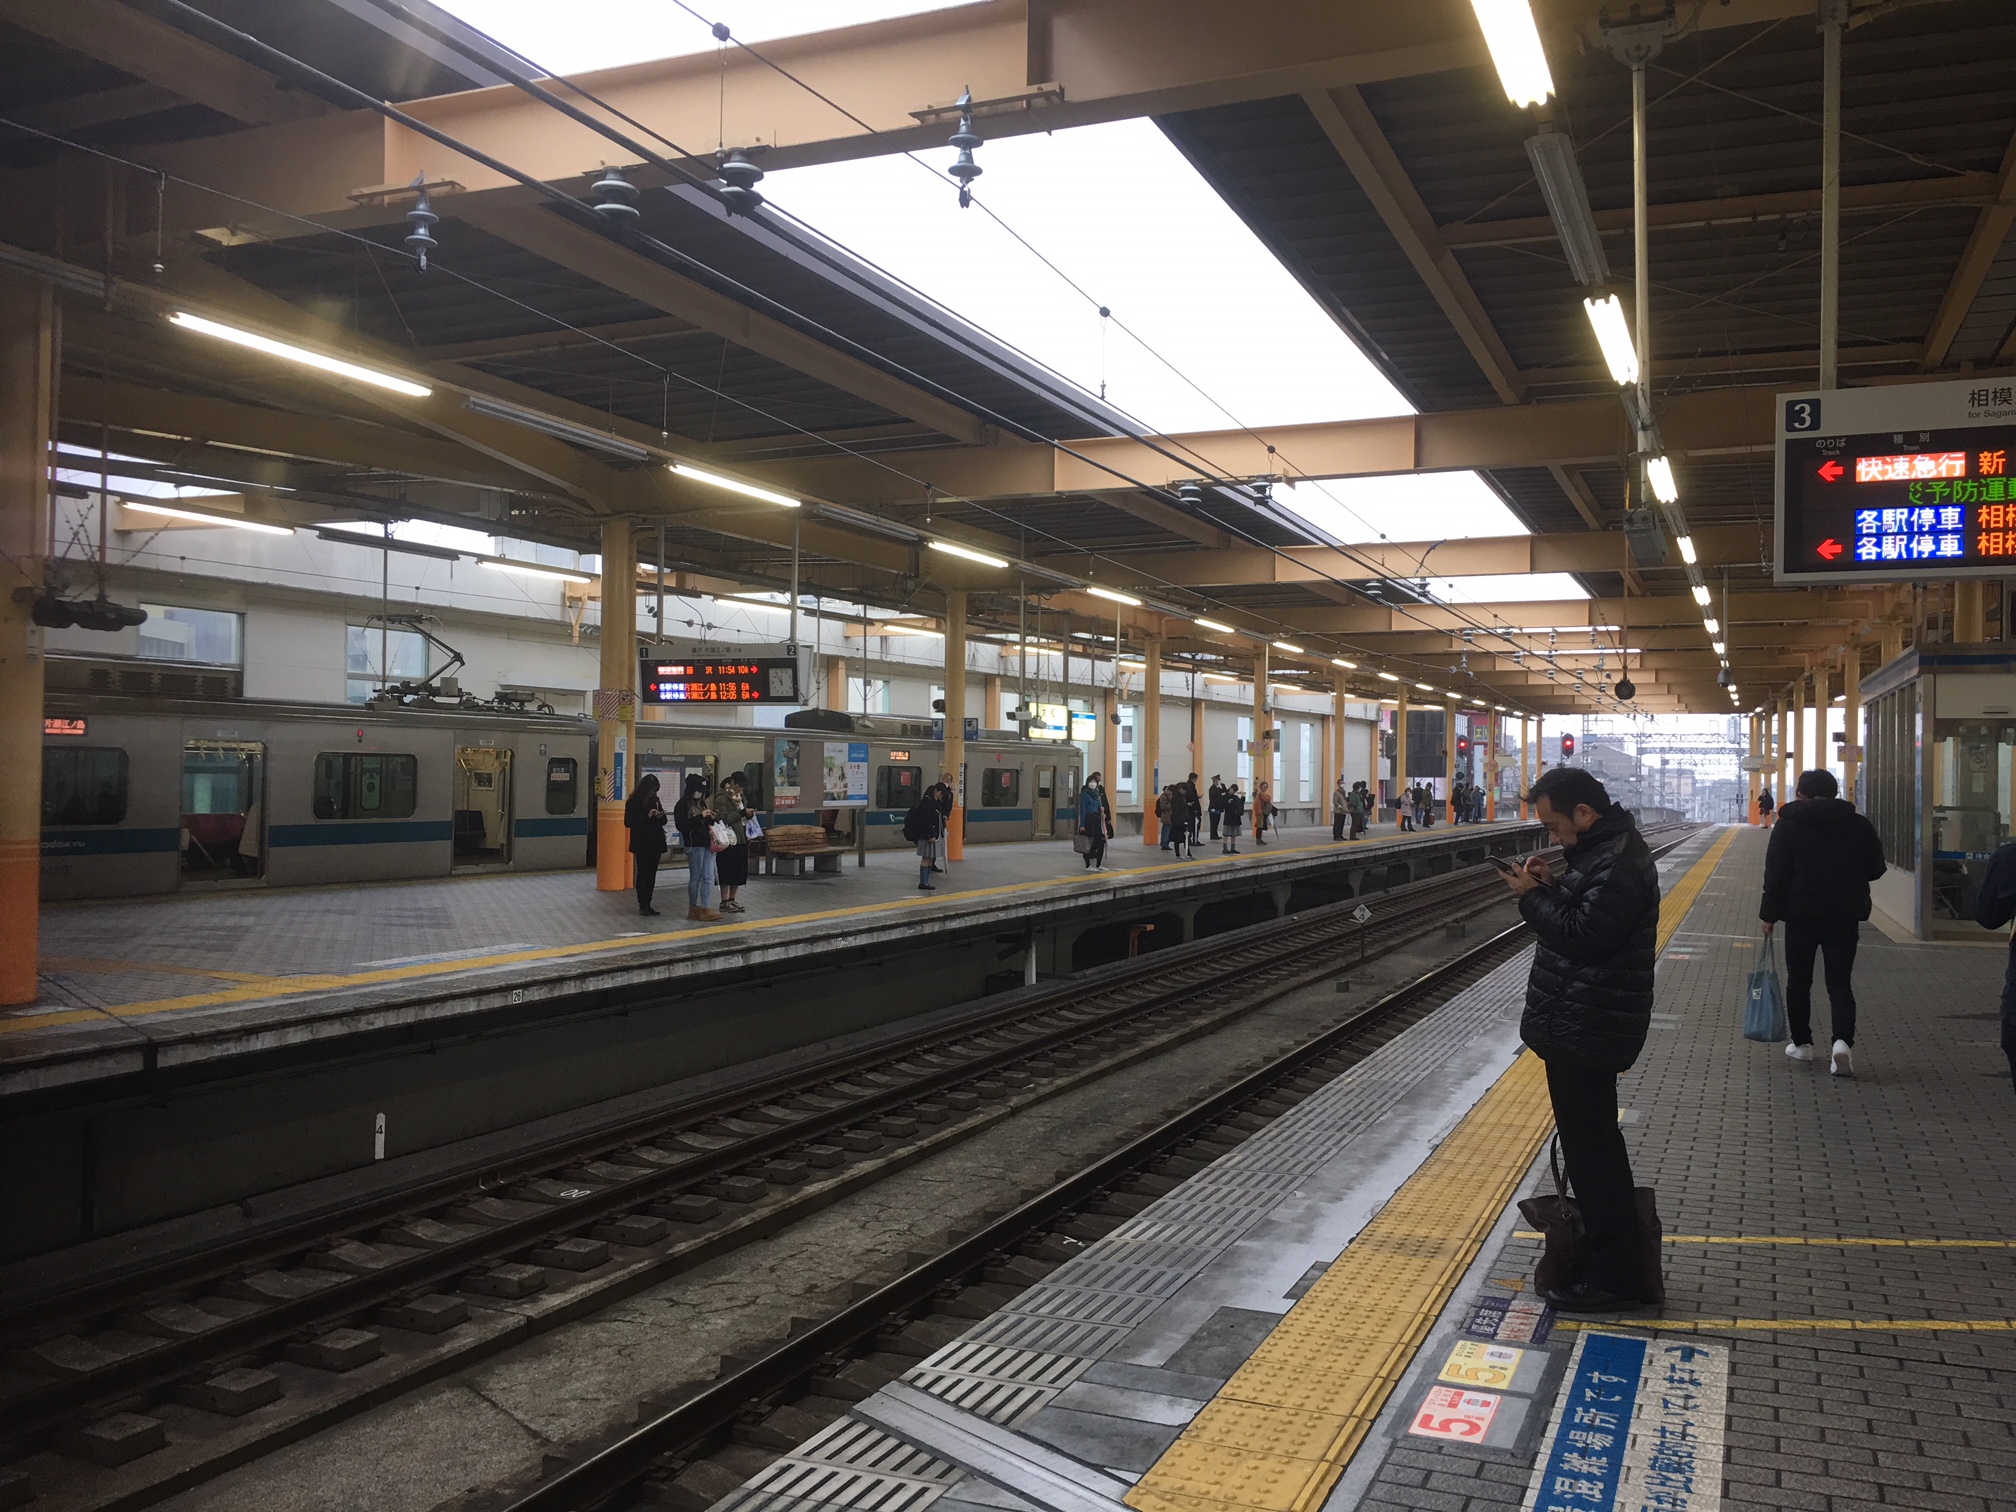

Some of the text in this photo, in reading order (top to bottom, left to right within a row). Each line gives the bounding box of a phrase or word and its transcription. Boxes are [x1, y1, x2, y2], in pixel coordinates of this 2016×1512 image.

[1968, 387, 2016, 408] 相模
[1793, 402, 1811, 429] 3
[1968, 410, 1980, 418] for
[1815, 437, 1847, 448] のりば
[1856, 450, 2006, 482] 快速急行 新
[1856, 506, 1963, 534] 各駅停車
[1856, 533, 1963, 560] 各駅停車
[788, 646, 795, 655] 2
[718, 665, 736, 674] 11:54
[376, 1124, 383, 1134] 4
[1445, 1362, 1507, 1384] 5
[1417, 1413, 1482, 1437] 5
